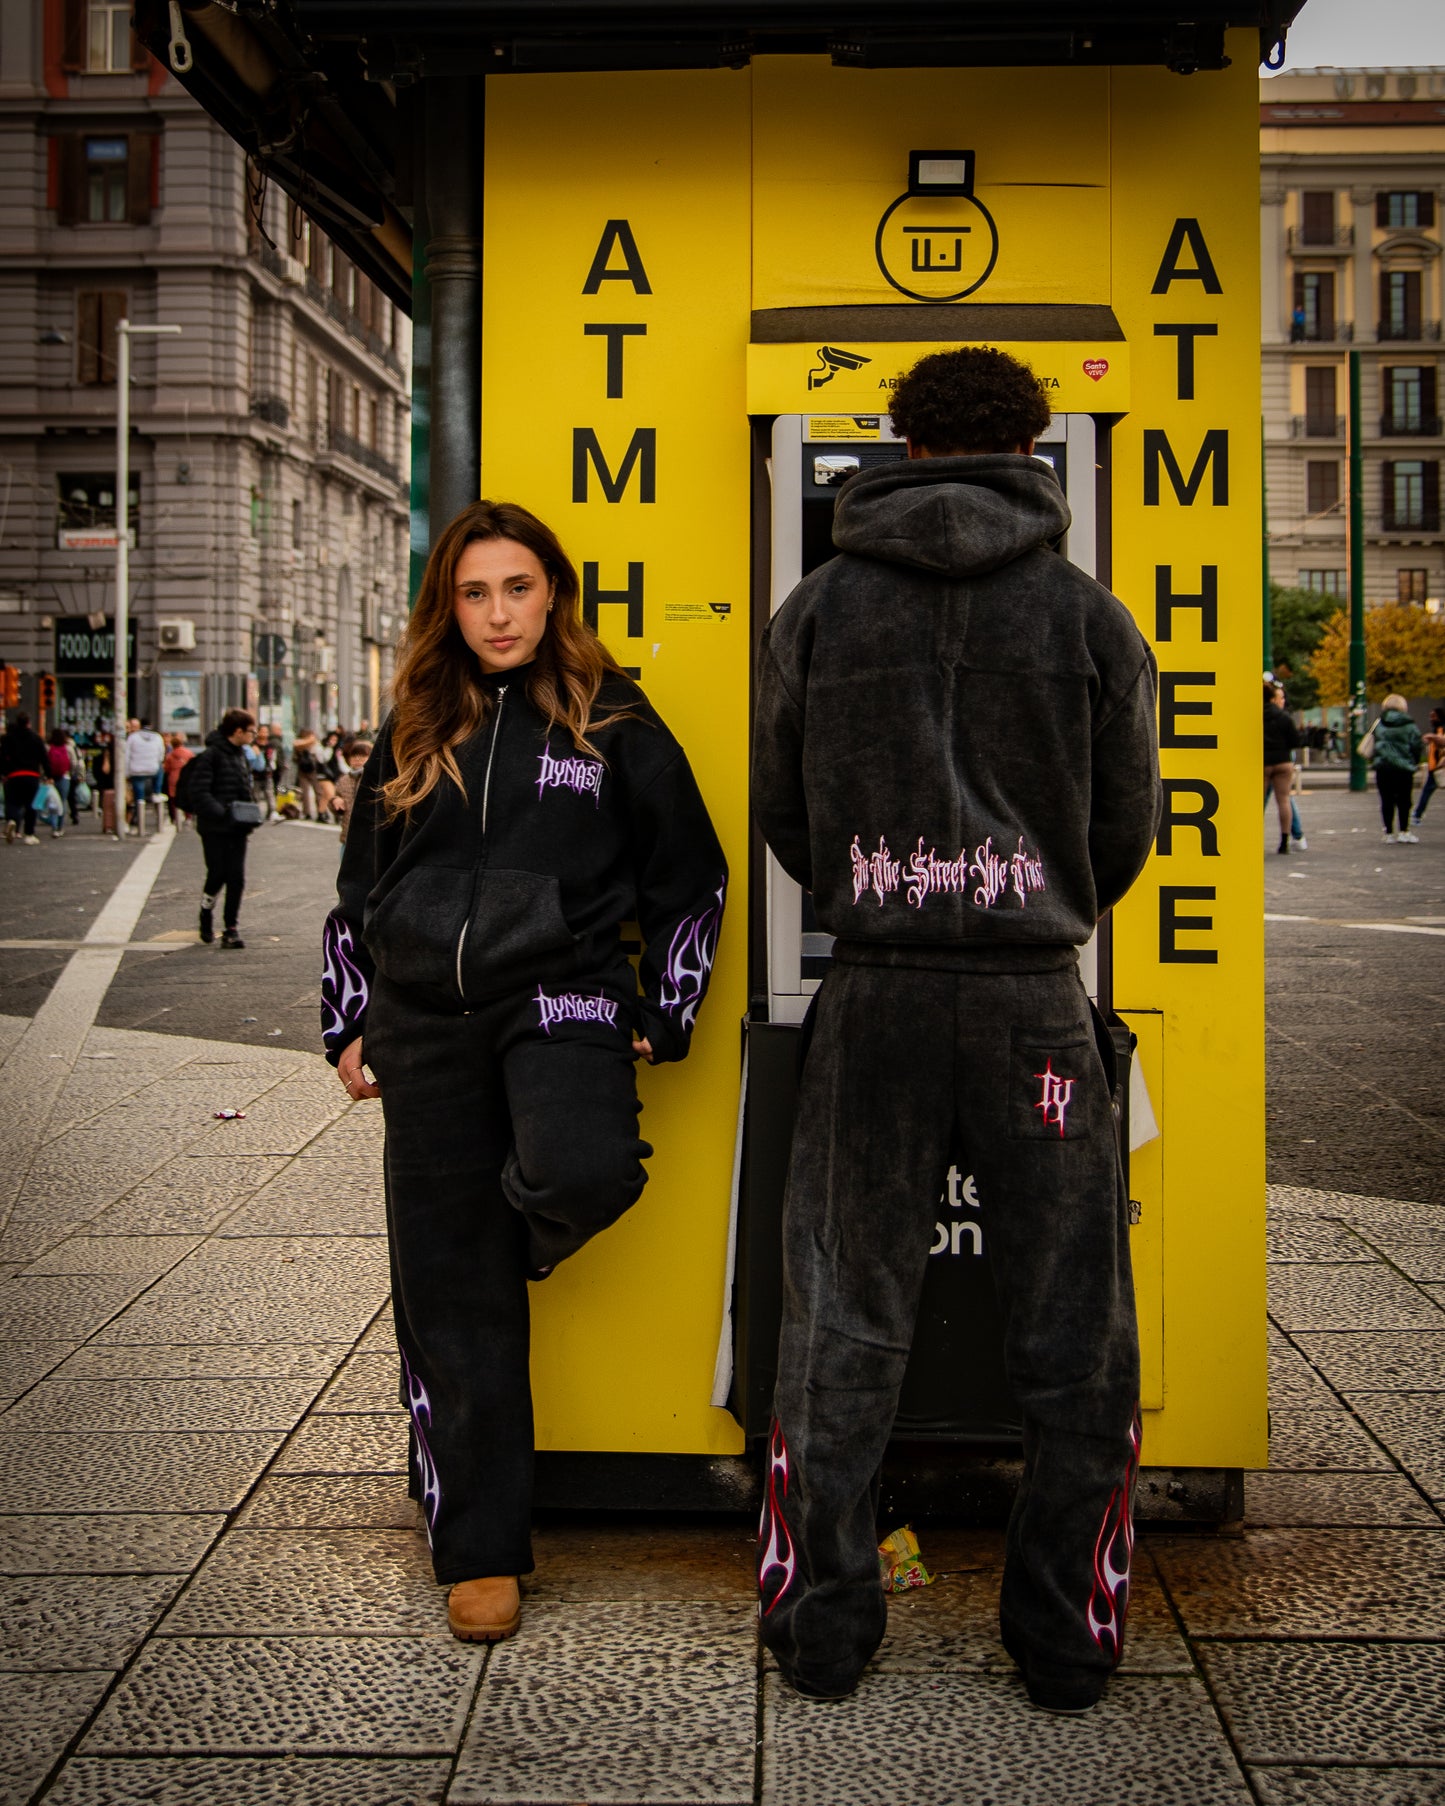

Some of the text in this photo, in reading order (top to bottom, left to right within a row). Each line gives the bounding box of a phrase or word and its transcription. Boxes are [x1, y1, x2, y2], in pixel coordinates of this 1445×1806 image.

[572, 219, 657, 504] ATM
[1085, 362, 1107, 371] Santo
[1143, 217, 1230, 964] ATM HERE
[59, 634, 135, 659] FOOD OUTT
[901, 835, 968, 910] Street
